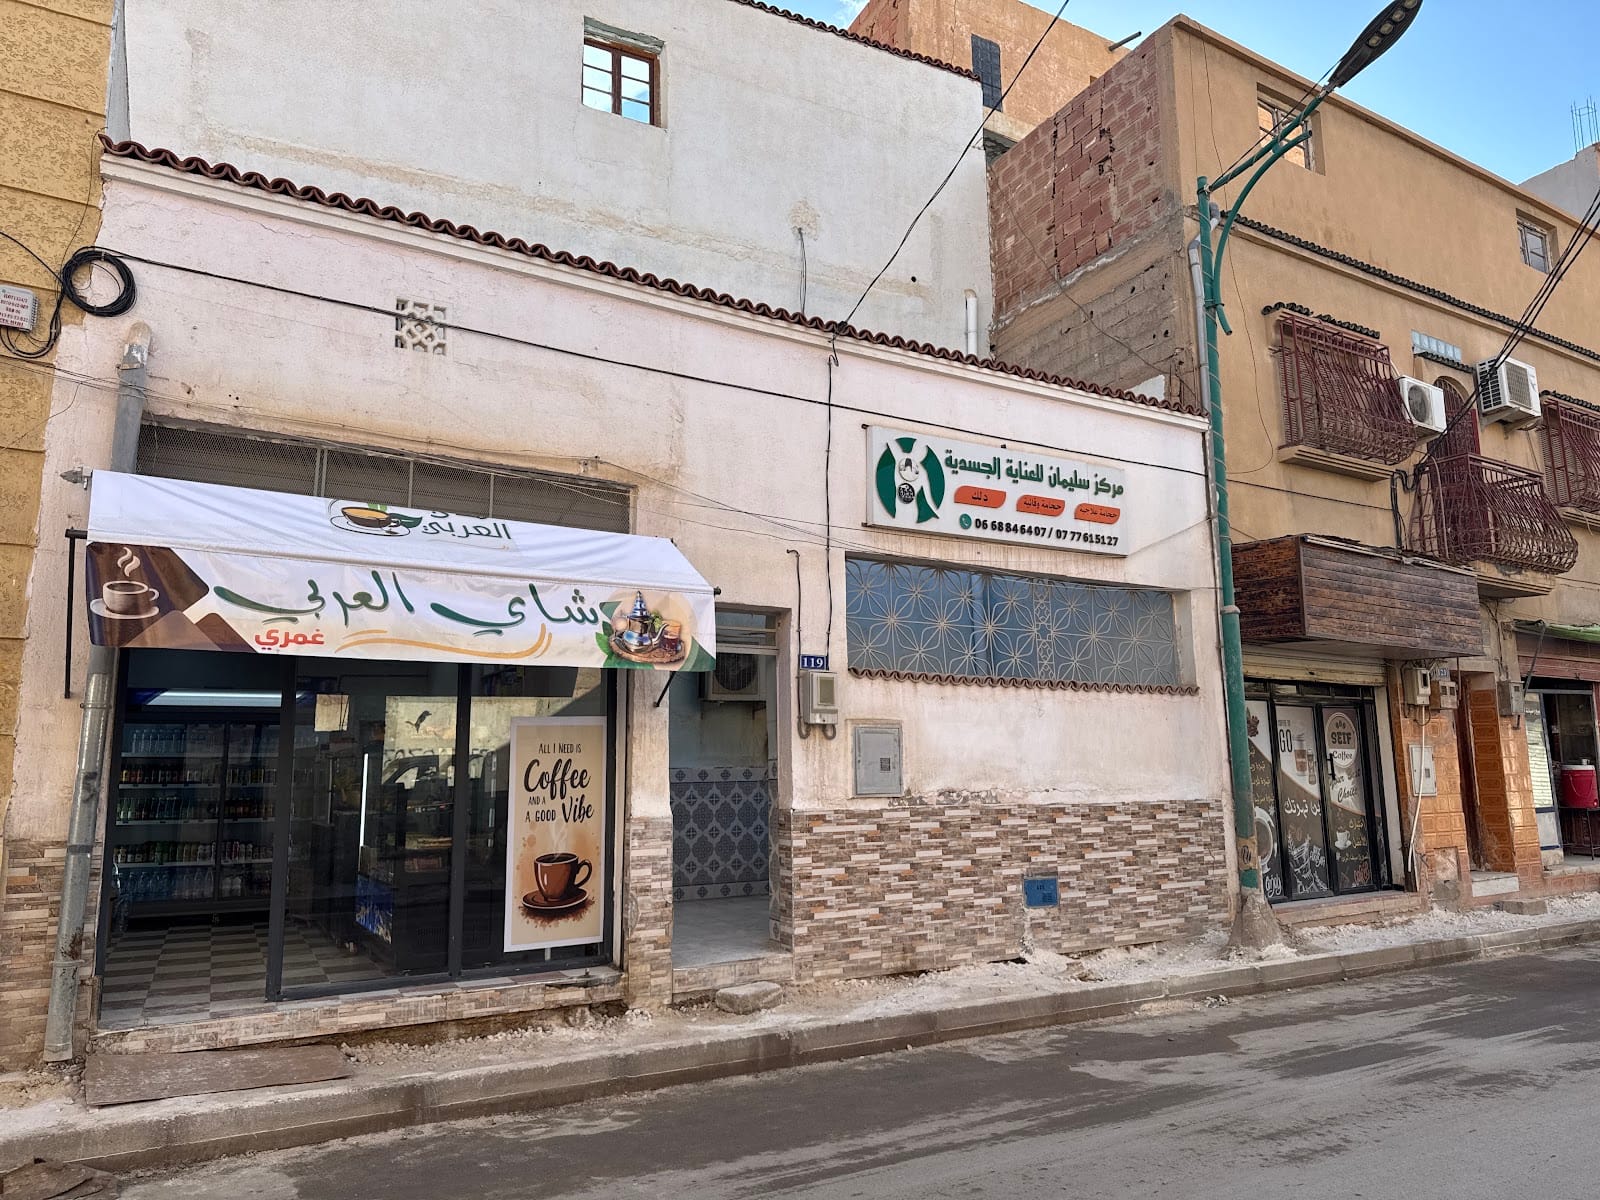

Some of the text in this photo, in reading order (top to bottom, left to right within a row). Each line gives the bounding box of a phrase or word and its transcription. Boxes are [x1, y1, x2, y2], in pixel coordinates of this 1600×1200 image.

[944, 449, 1125, 499] مركز سليمان للعناية الجسدية
[421, 520, 513, 540] العربي
[213, 570, 600, 637] شاي العربي
[254, 626, 325, 653] غمري
[802, 656, 824, 668] 119
[1278, 728, 1293, 753] GO
[1331, 731, 1352, 745] SEIF
[1331, 750, 1353, 761] Coffee
[523, 758, 592, 801] Coffee
[525, 794, 595, 824] A GOOD Vibe
[1283, 796, 1309, 819] قهوتك
